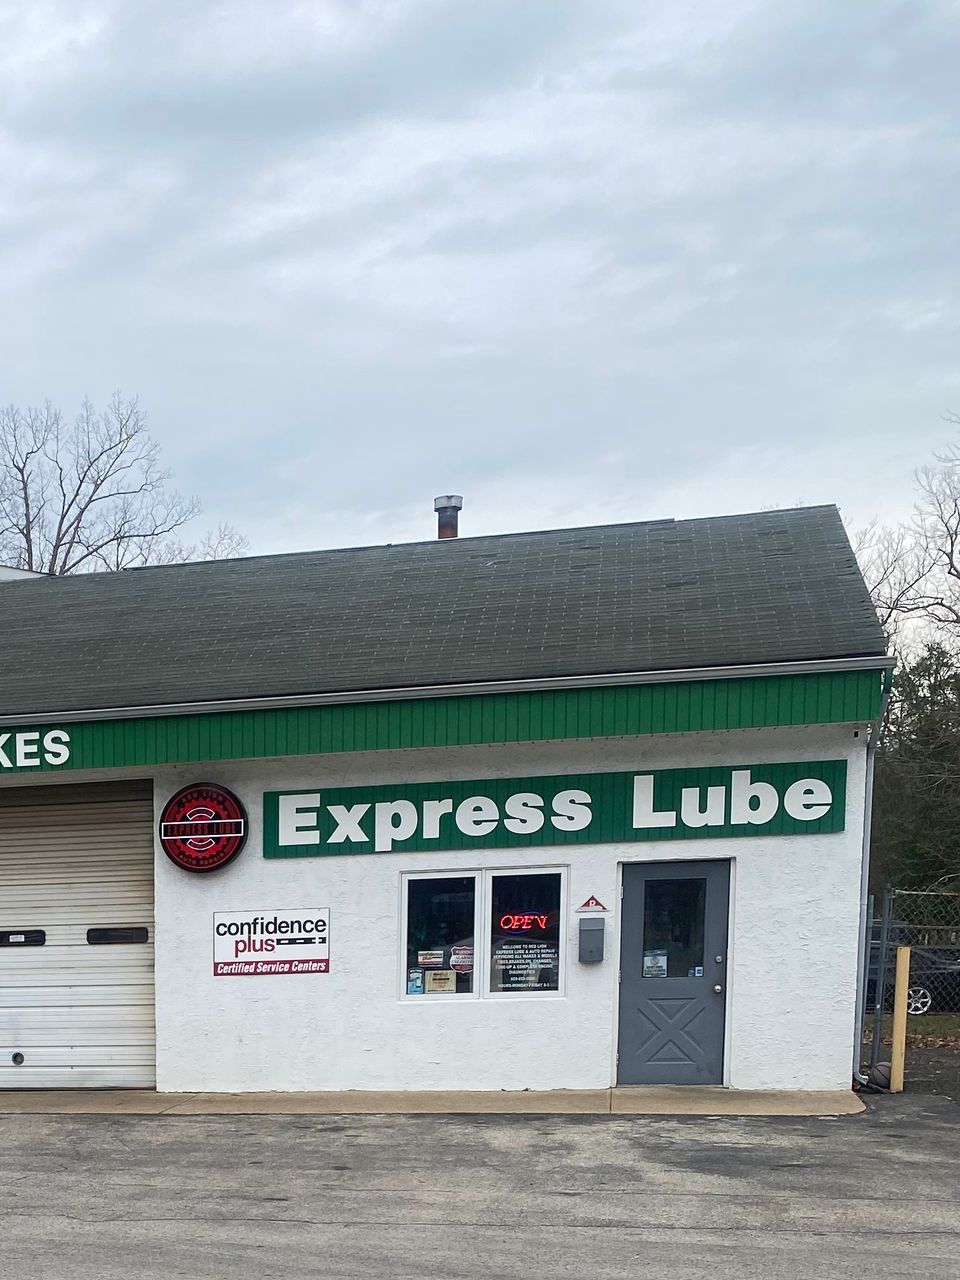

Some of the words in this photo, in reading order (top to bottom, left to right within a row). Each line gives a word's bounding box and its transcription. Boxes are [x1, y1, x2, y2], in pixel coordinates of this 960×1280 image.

[277, 789, 594, 853] Express
[631, 769, 833, 829] Lube
[167, 823, 209, 836] EXPRESS
[213, 822, 237, 835] LUBE
[216, 916, 327, 936] confidence
[500, 915, 548, 929] OPEN
[234, 934, 276, 958] plus
[217, 962, 255, 974] Certified
[256, 962, 290, 973] Service
[291, 960, 326, 972] Centers
